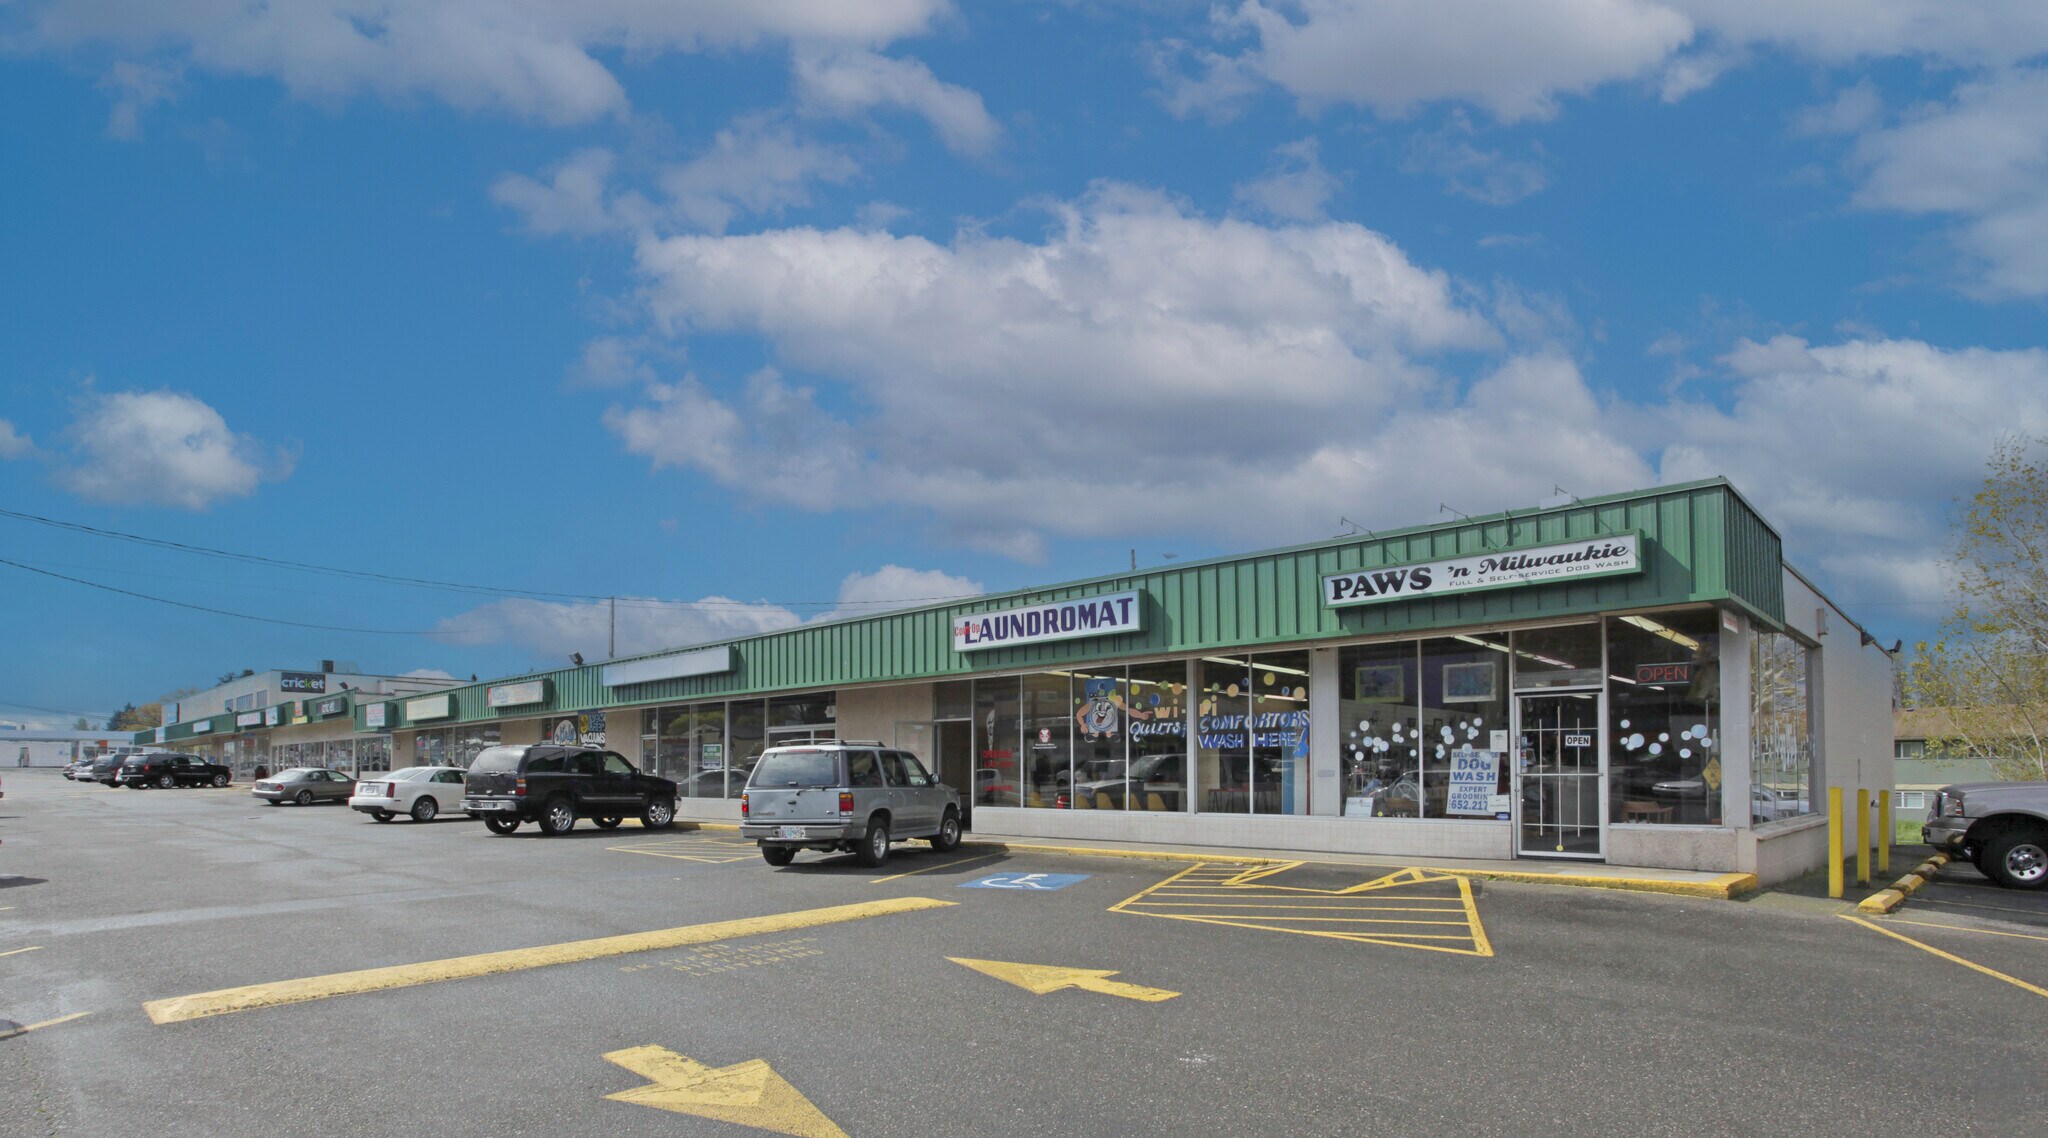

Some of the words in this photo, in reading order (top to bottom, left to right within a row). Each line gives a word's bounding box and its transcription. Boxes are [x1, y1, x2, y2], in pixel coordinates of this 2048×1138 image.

[1330, 566, 1433, 600] PAWS
[1477, 543, 1629, 574] Milwaukie
[1566, 564, 1590, 573] DOG
[1595, 560, 1629, 569] WASH
[964, 597, 1134, 645] LAUNDROMAT
[1636, 666, 1689, 682] OPEN
[281, 678, 325, 690] cricket
[1197, 733, 1245, 749] WASH
[1566, 736, 1590, 745] OPEN
[1457, 758, 1491, 771] DOG
[1452, 771, 1496, 781] WASH
[1451, 799, 1489, 811] 652.217
